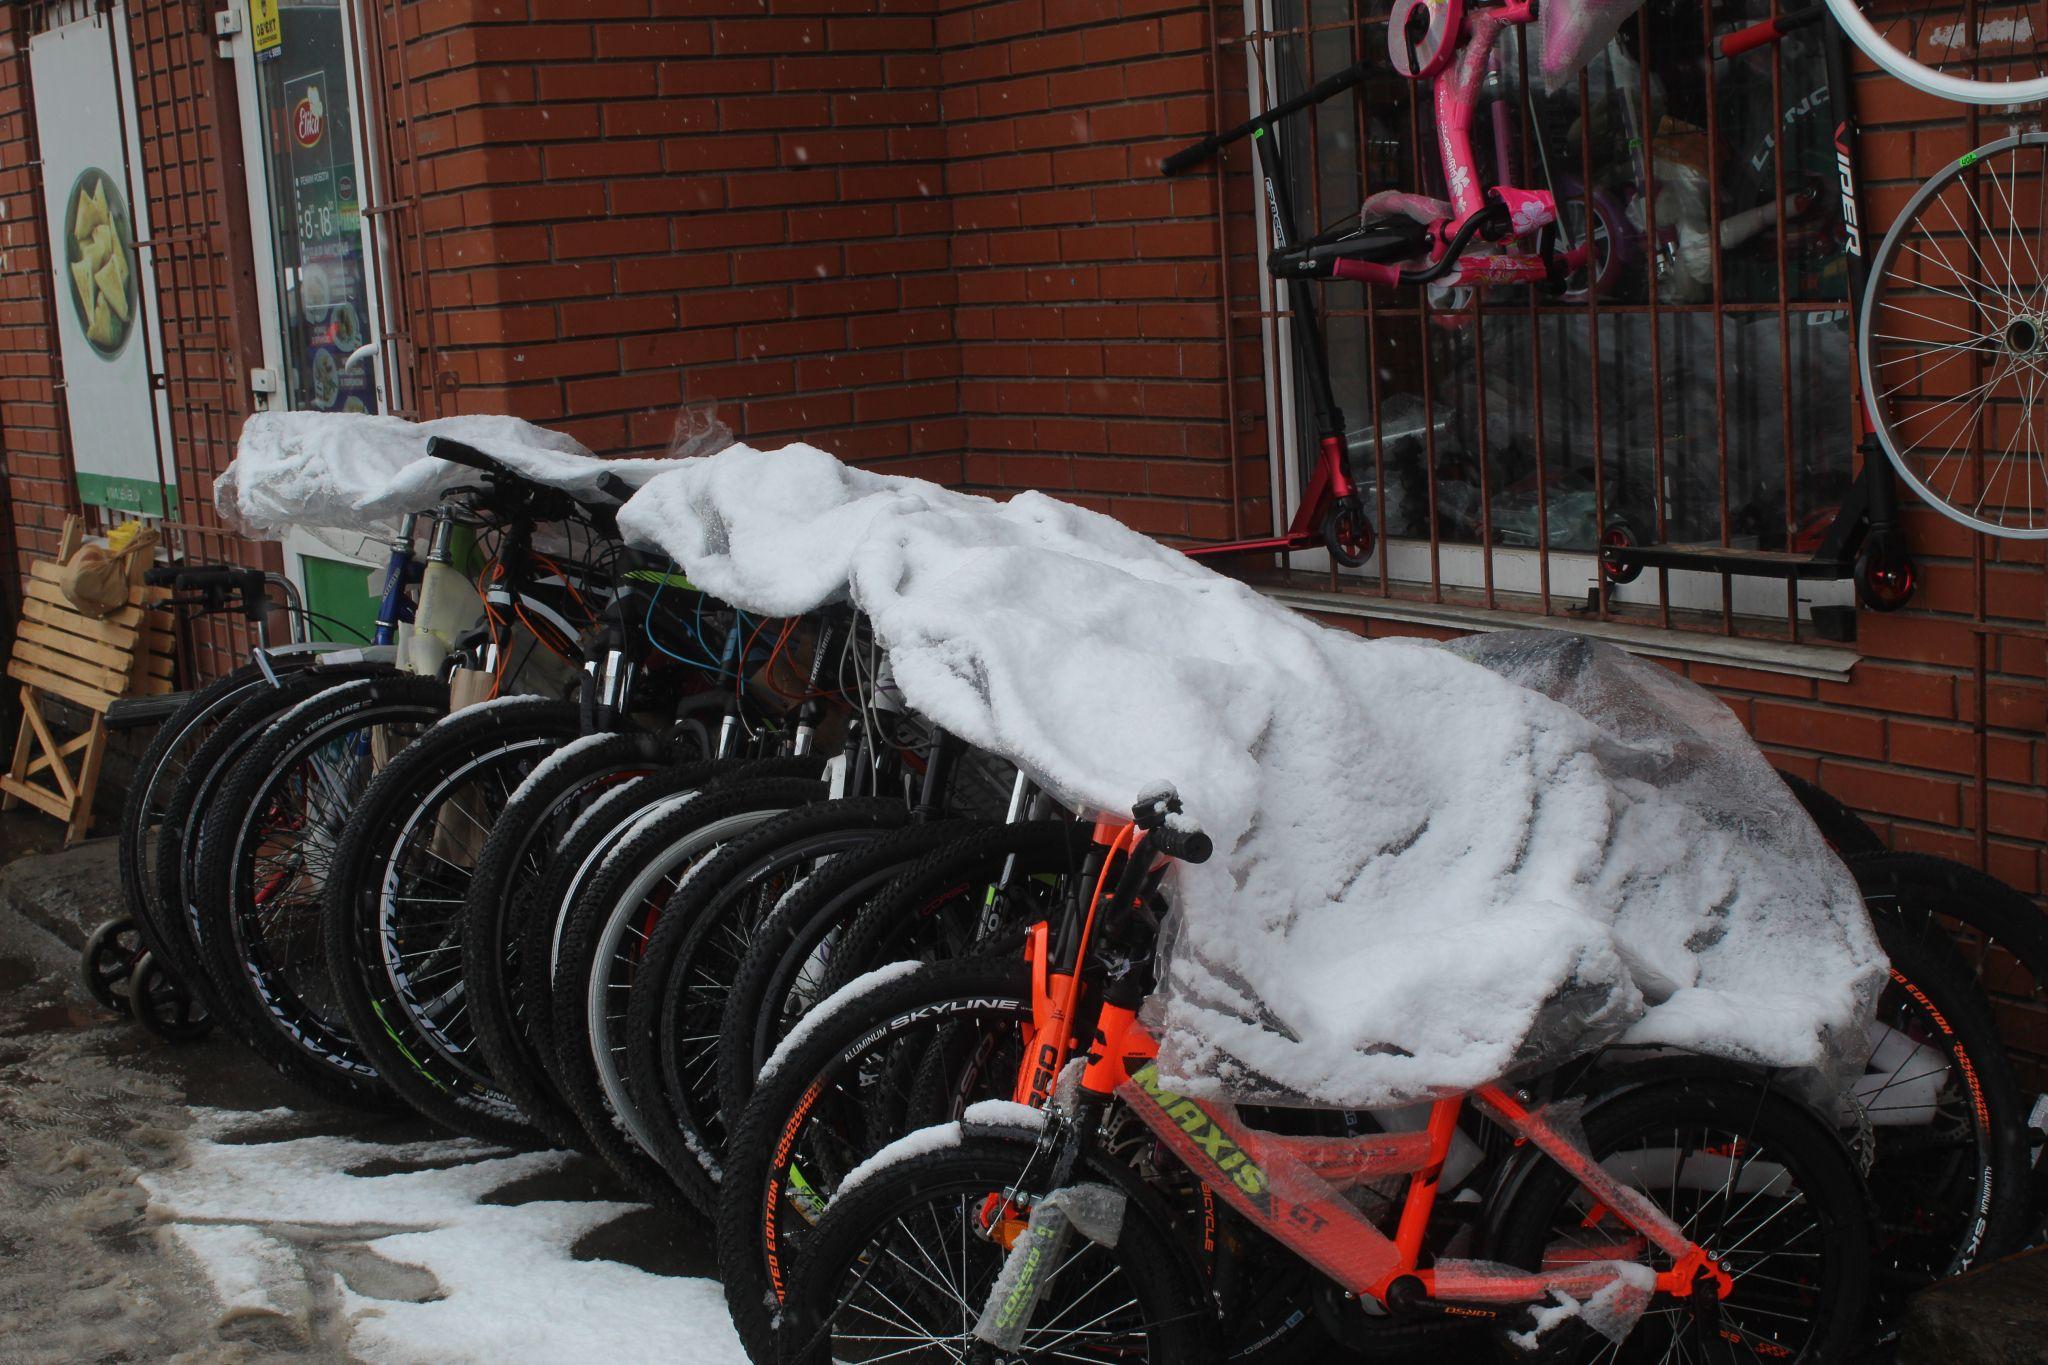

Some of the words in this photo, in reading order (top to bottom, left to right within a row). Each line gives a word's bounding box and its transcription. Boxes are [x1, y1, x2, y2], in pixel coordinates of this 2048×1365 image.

[1833, 121, 1862, 257] VIPER
[844, 1026, 888, 1063] ALUMINUM
[890, 998, 1019, 1030] SKYLINE
[1905, 983, 1954, 1035] EDITION
[1131, 1063, 1268, 1195] MAXIS
[764, 1178, 780, 1251] EDITION
[1200, 1181, 1216, 1253] BICYCLE
[1979, 1166, 1993, 1215] ALUMINUM
